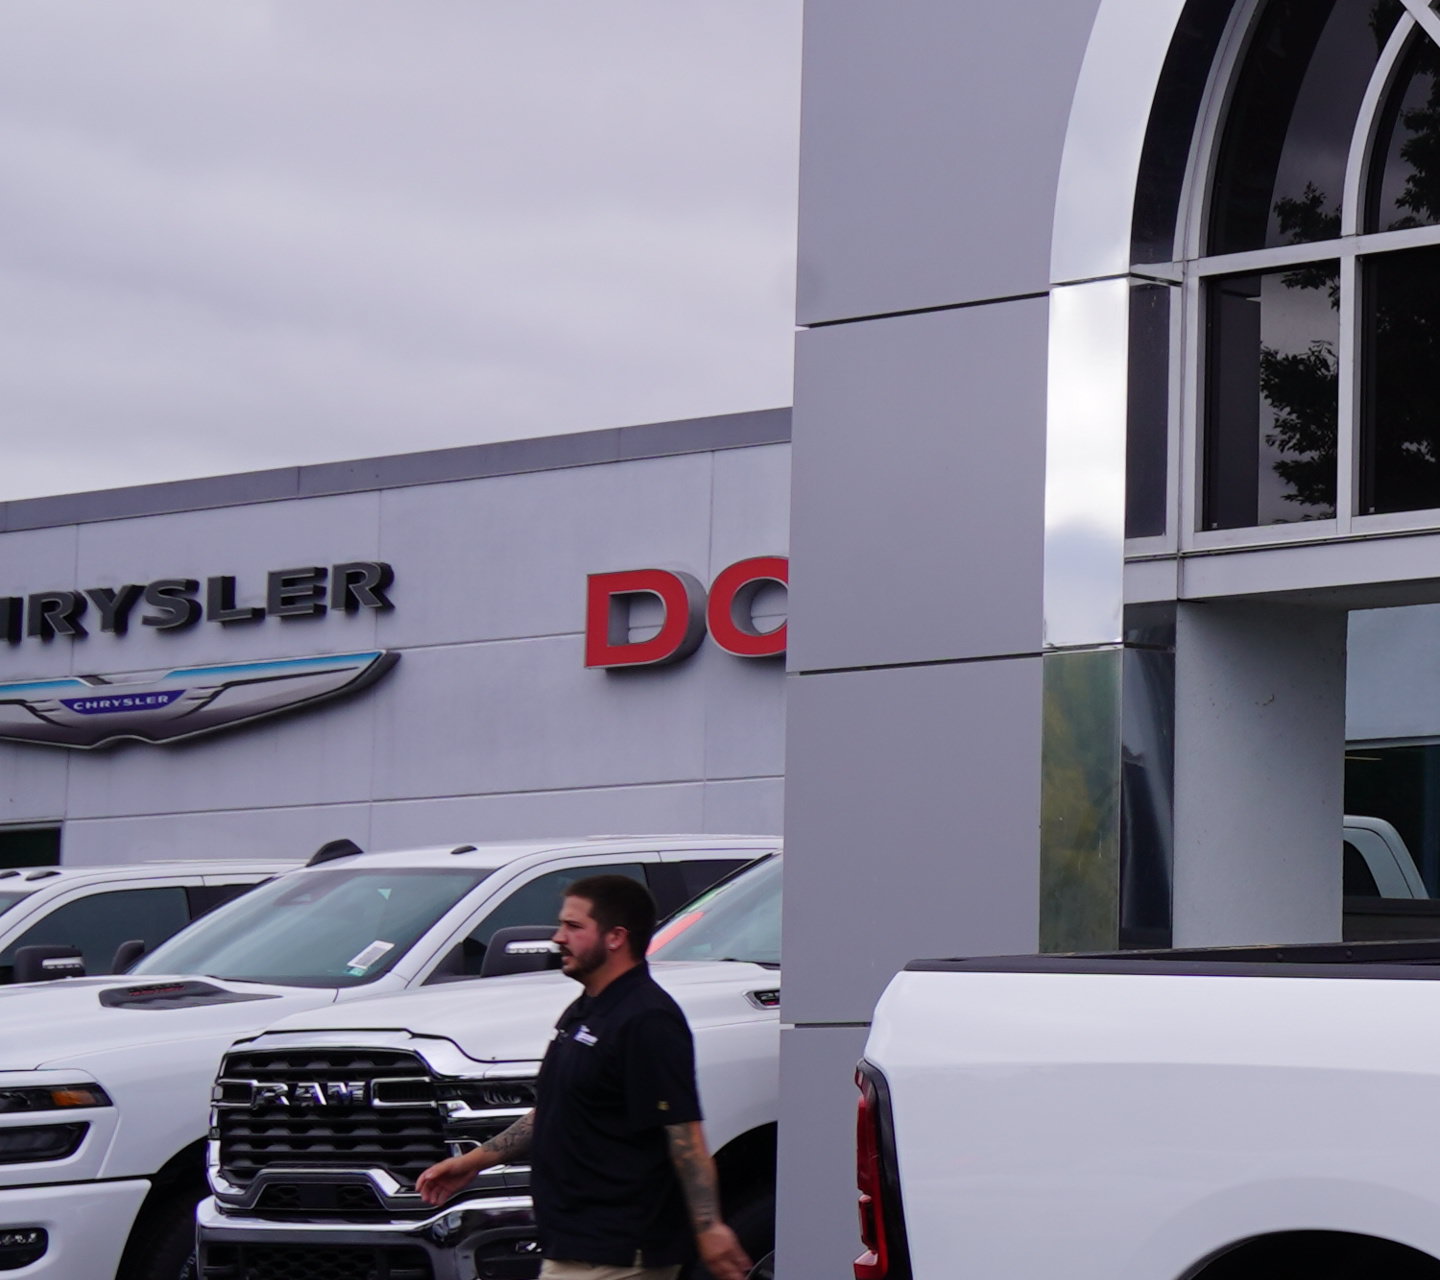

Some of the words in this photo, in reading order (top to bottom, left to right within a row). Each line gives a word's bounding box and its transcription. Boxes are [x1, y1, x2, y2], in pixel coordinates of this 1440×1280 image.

[0, 562, 395, 645] RYSLER
[73, 695, 169, 710] CHRYSLER
[252, 1081, 366, 1108] RAM
